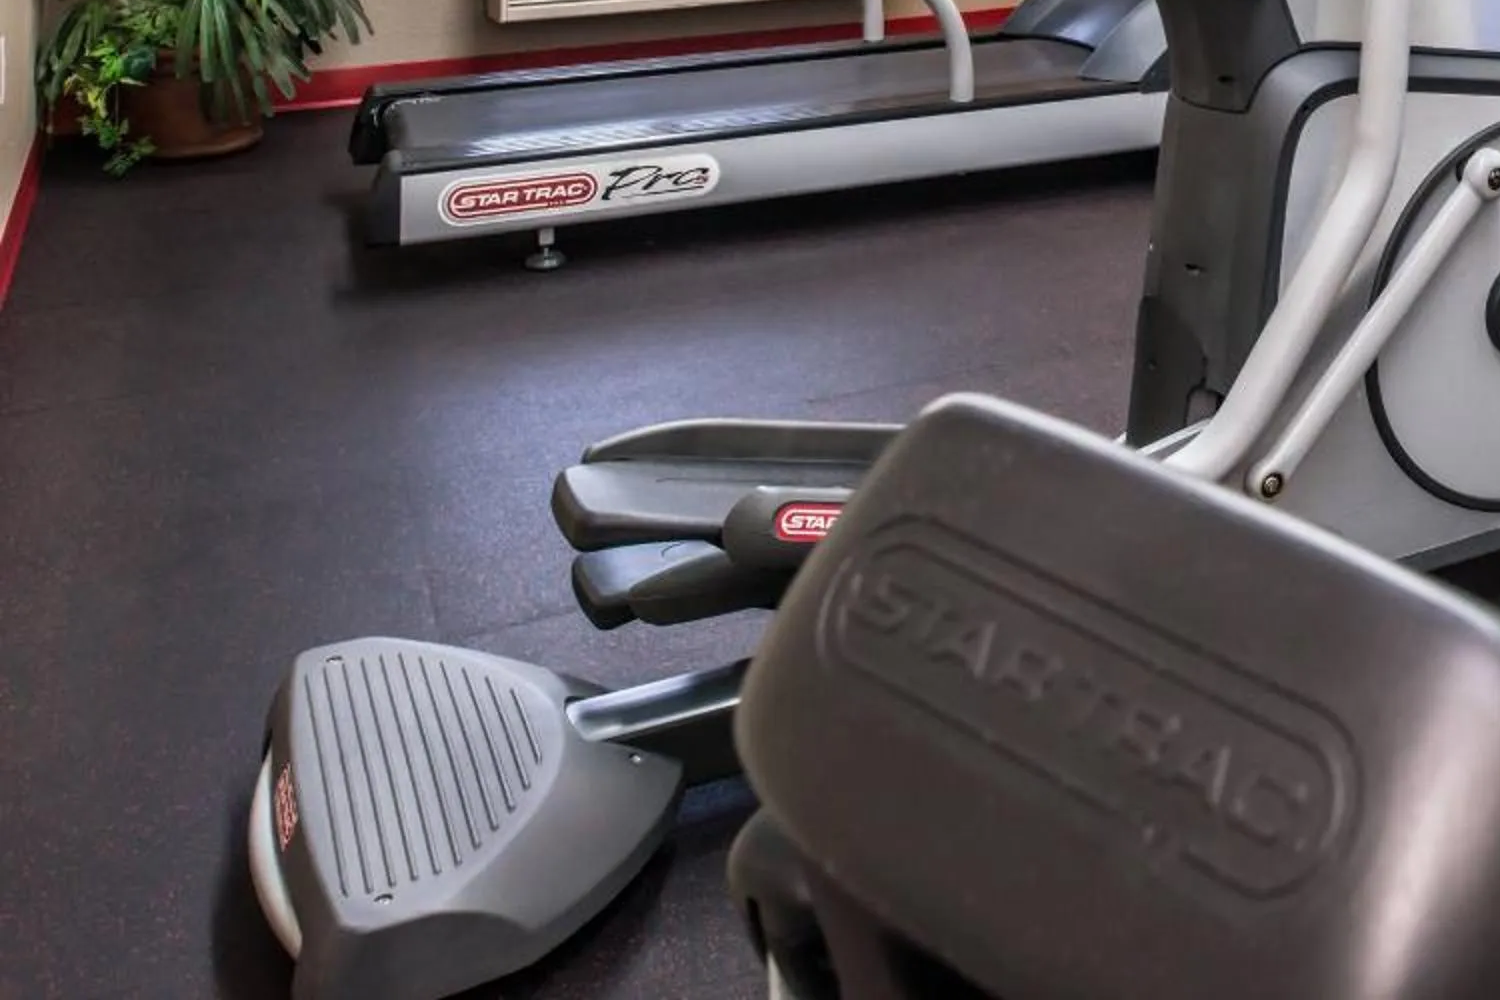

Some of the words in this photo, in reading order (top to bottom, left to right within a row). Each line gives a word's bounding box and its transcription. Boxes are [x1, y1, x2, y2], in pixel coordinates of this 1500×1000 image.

[460, 190, 518, 209] STAR
[522, 182, 586, 202] TRAC
[853, 572, 1064, 700] STAR
[1068, 674, 1310, 850] TRAC
